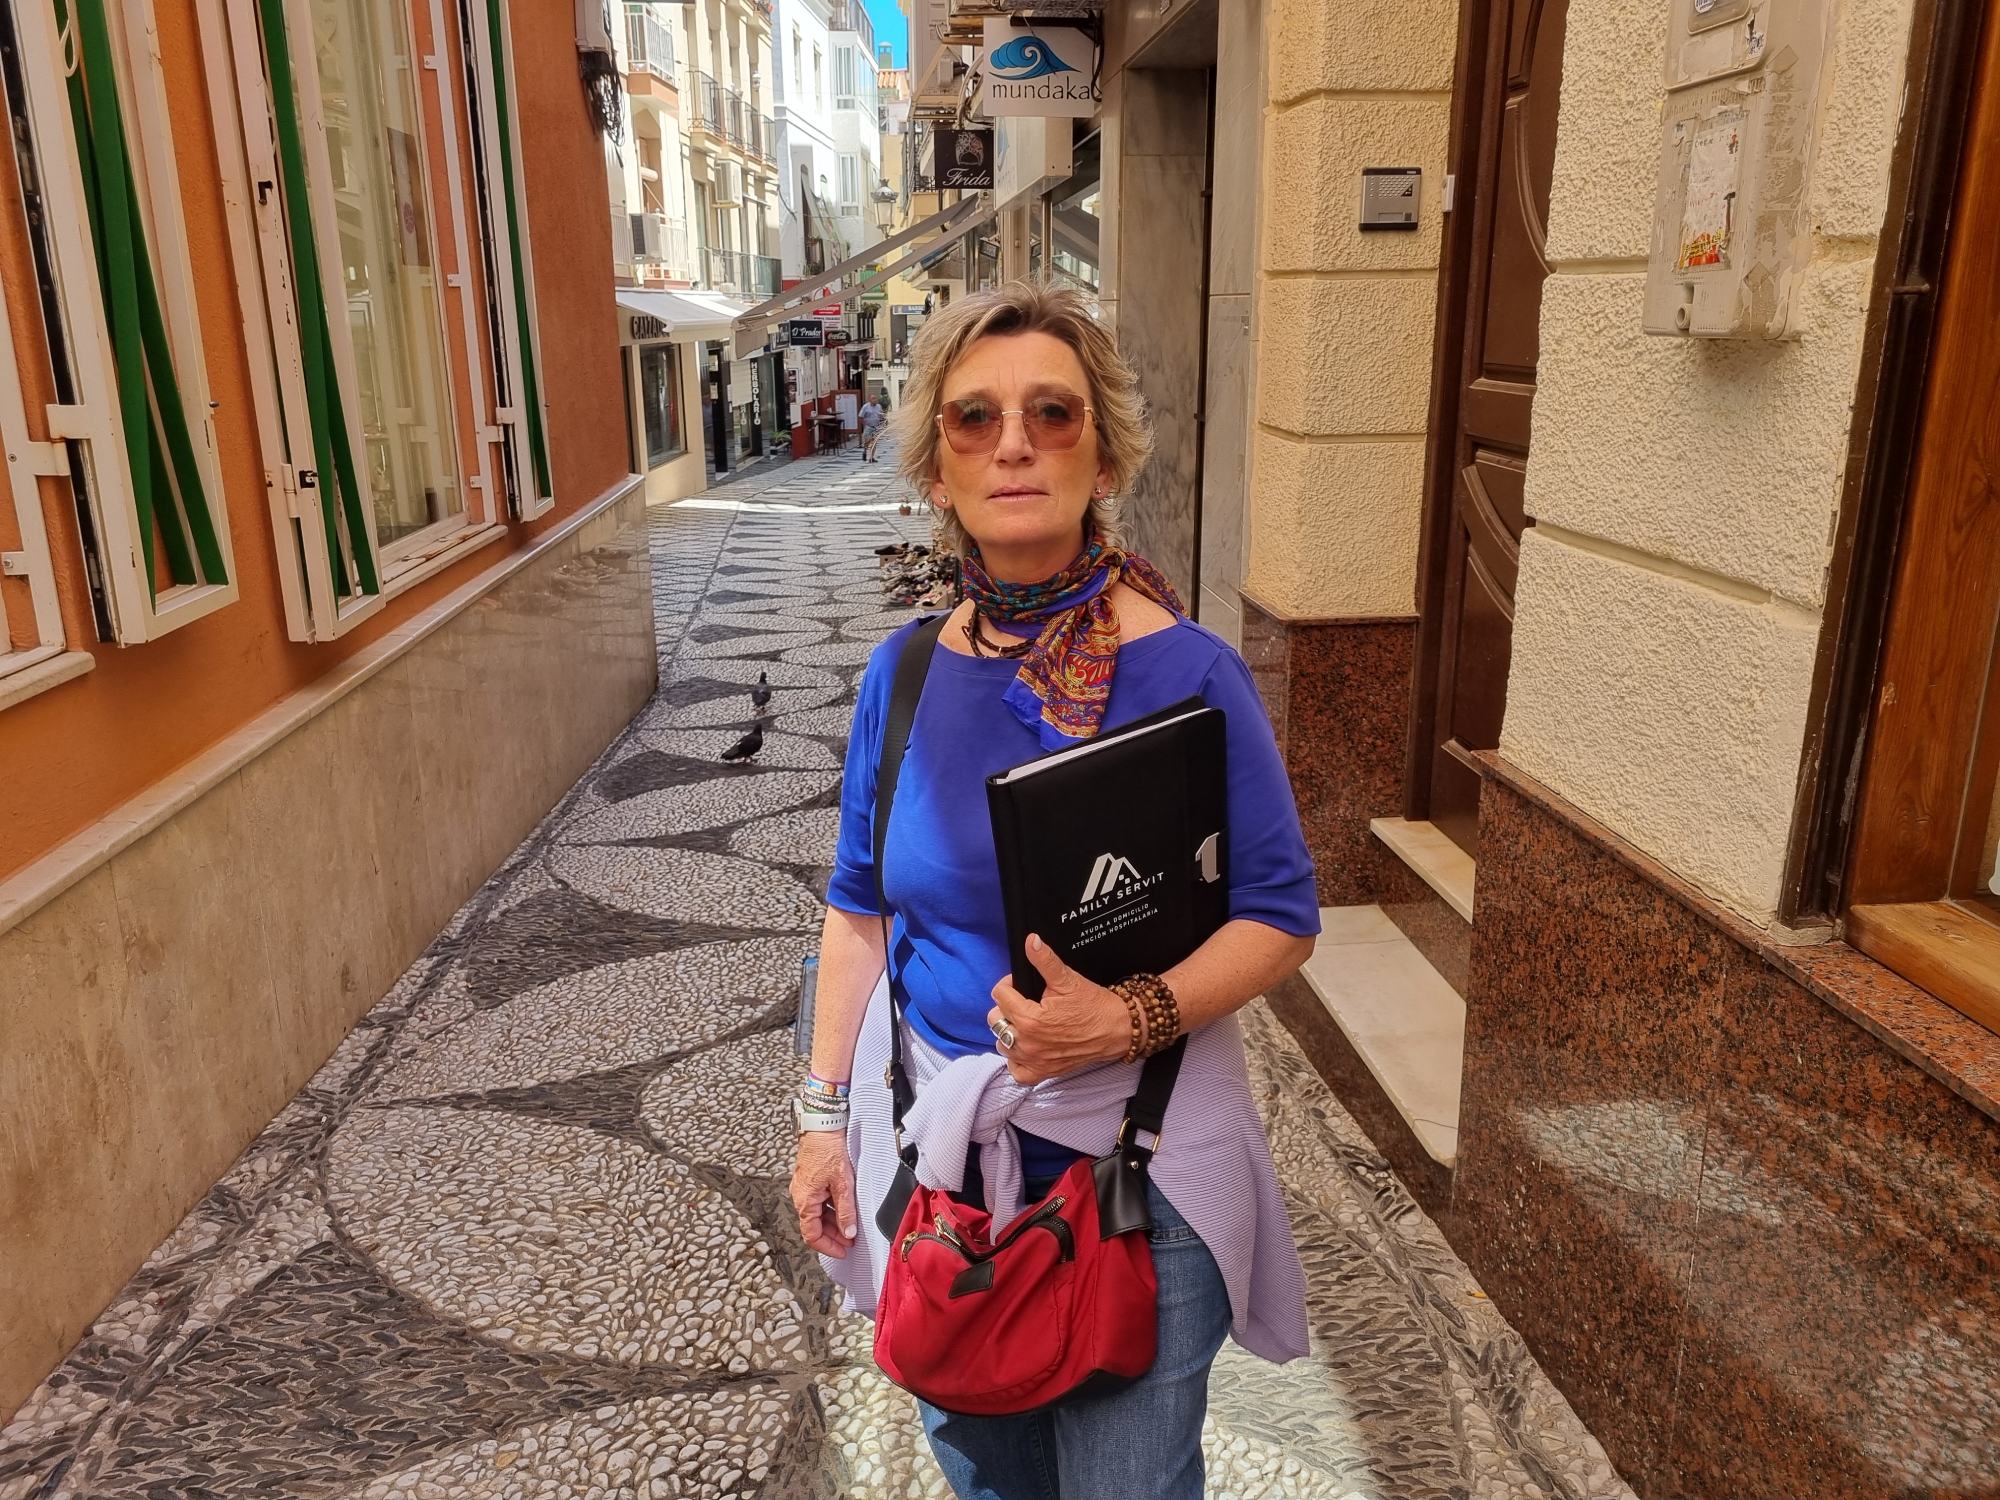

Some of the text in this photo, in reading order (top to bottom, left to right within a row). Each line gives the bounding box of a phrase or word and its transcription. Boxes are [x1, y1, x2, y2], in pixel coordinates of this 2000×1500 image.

[992, 75, 1090, 100] mundaka
[942, 167, 991, 186] Frida
[751, 361, 761, 426] HERBOLARIO
[1061, 871, 1164, 923] FAMILY SERVIT
[1080, 923, 1104, 938] AYUDA
[1113, 903, 1150, 924] DOMICILIO
[1109, 907, 1159, 934] HOSPITALARIA
